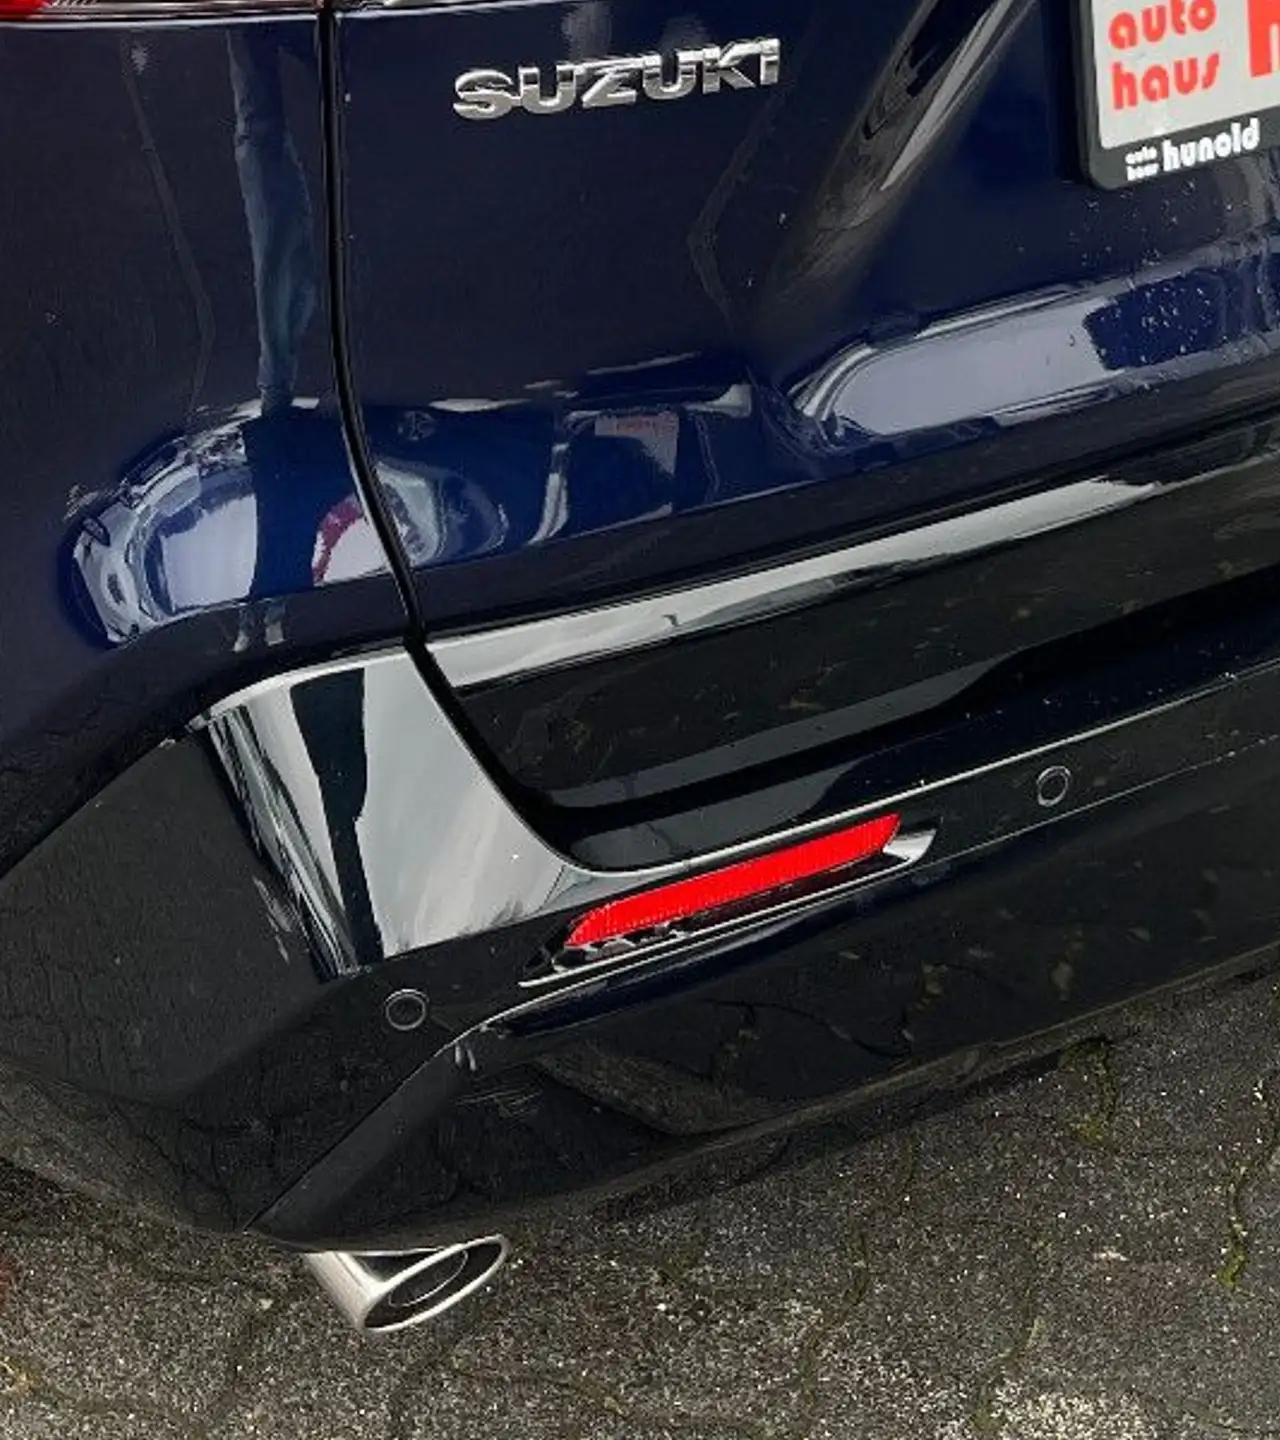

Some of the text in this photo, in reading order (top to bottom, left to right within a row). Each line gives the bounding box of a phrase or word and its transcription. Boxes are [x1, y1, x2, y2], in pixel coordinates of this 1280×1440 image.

[453, 37, 781, 121] SUZUKI
[1111, 53, 1220, 111] haus
[1161, 116, 1261, 173] hunold
